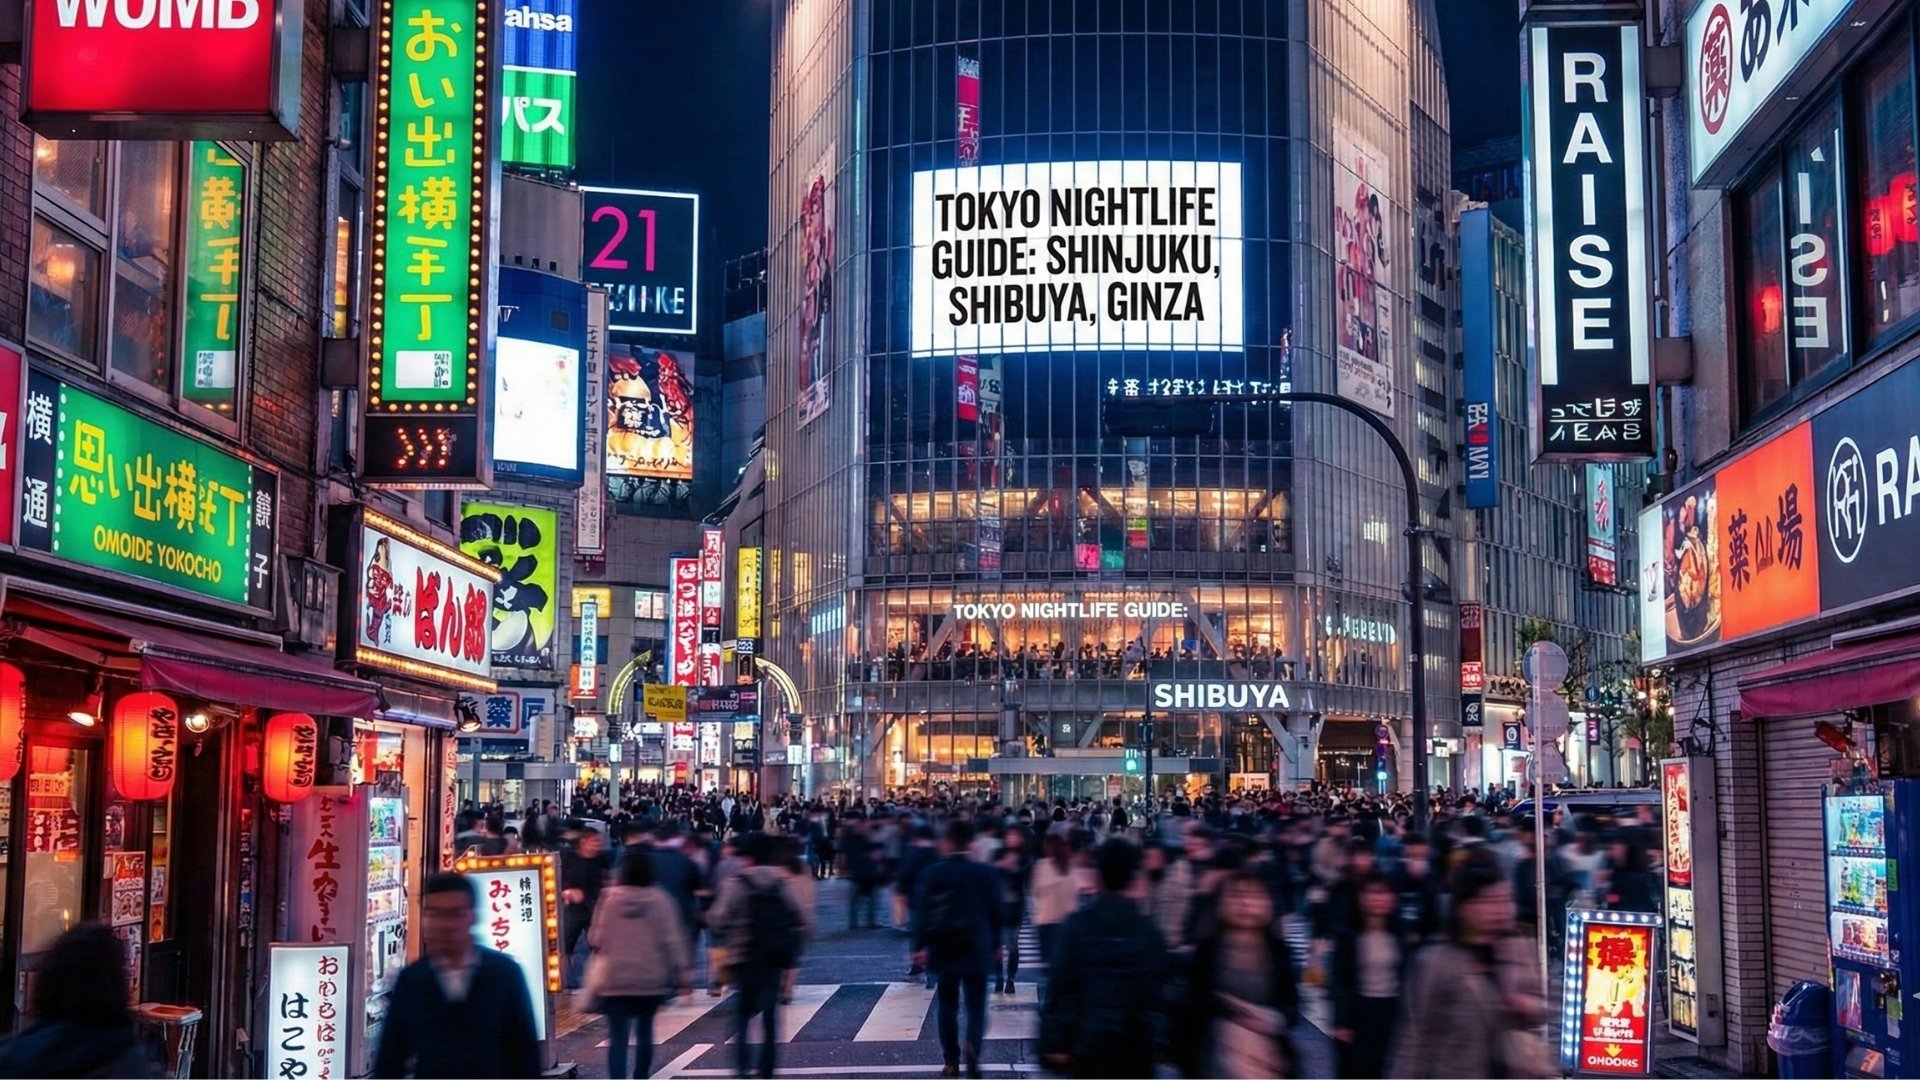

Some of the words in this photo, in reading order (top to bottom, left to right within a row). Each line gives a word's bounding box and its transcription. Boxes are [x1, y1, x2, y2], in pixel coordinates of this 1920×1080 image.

[935, 189, 1040, 231] TOKYO
[1051, 187, 1216, 226] NIGHTLIFE
[1563, 52, 1614, 350] RAISE
[590, 206, 656, 271] 21
[932, 237, 1036, 279] GUIDE:
[1046, 234, 1220, 279] SHINJUKU,
[949, 282, 1096, 326] SHIBUYA,
[1108, 281, 1204, 322] GINZA
[94, 525, 153, 564] OMOIDE
[157, 543, 222, 583] YOKOCHO
[953, 604, 1016, 619] TOKYO
[1021, 603, 1119, 618] NIGHTLIFE
[1124, 602, 1188, 618] GUIDE:
[1154, 683, 1290, 708] SHIBUYA
[279, 992, 309, 1080] はこや
